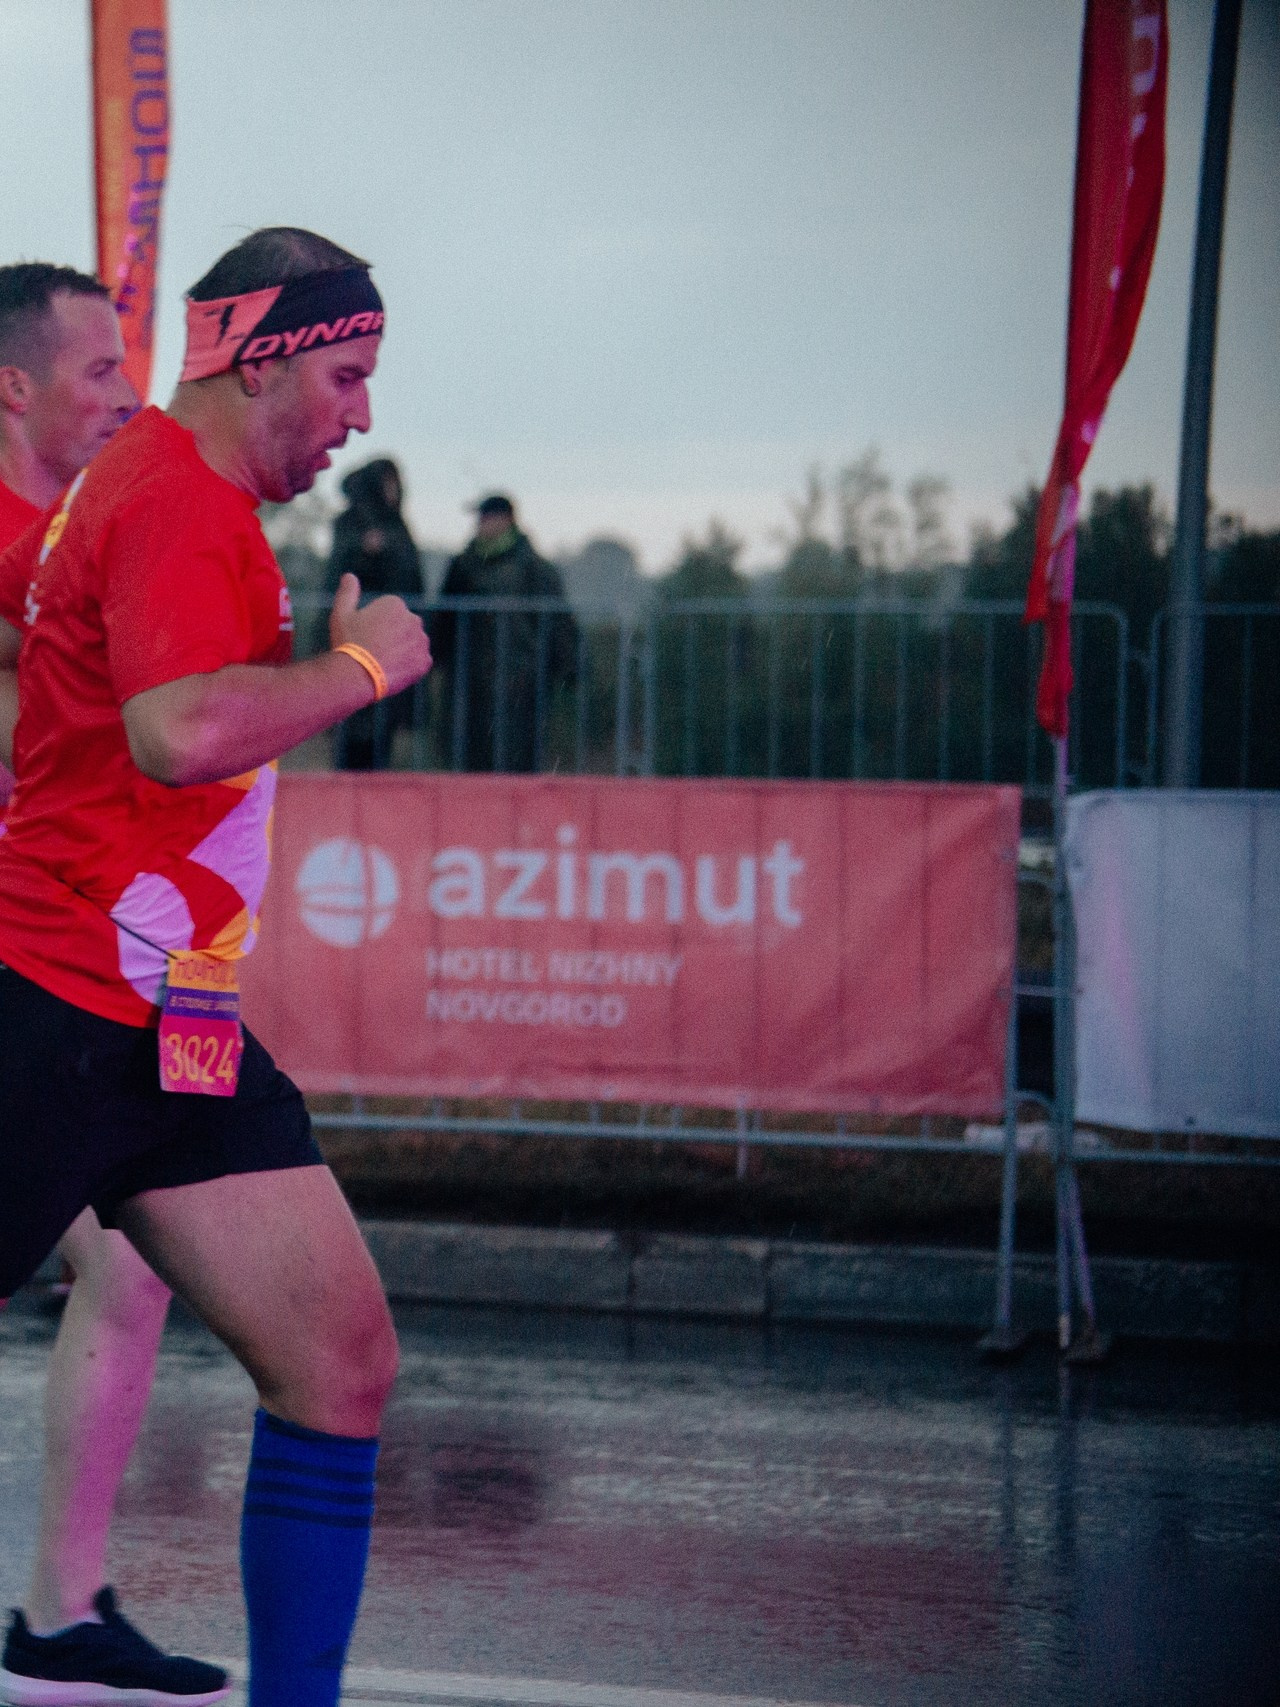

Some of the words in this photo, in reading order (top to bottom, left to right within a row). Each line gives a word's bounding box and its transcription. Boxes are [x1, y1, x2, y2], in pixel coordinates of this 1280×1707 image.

[429, 824, 805, 928] azimut
[426, 947, 539, 982] HOTEL
[548, 951, 684, 986] NIZHNY
[426, 989, 628, 1028] NOVGOROD
[165, 1032, 235, 1085] 3024
